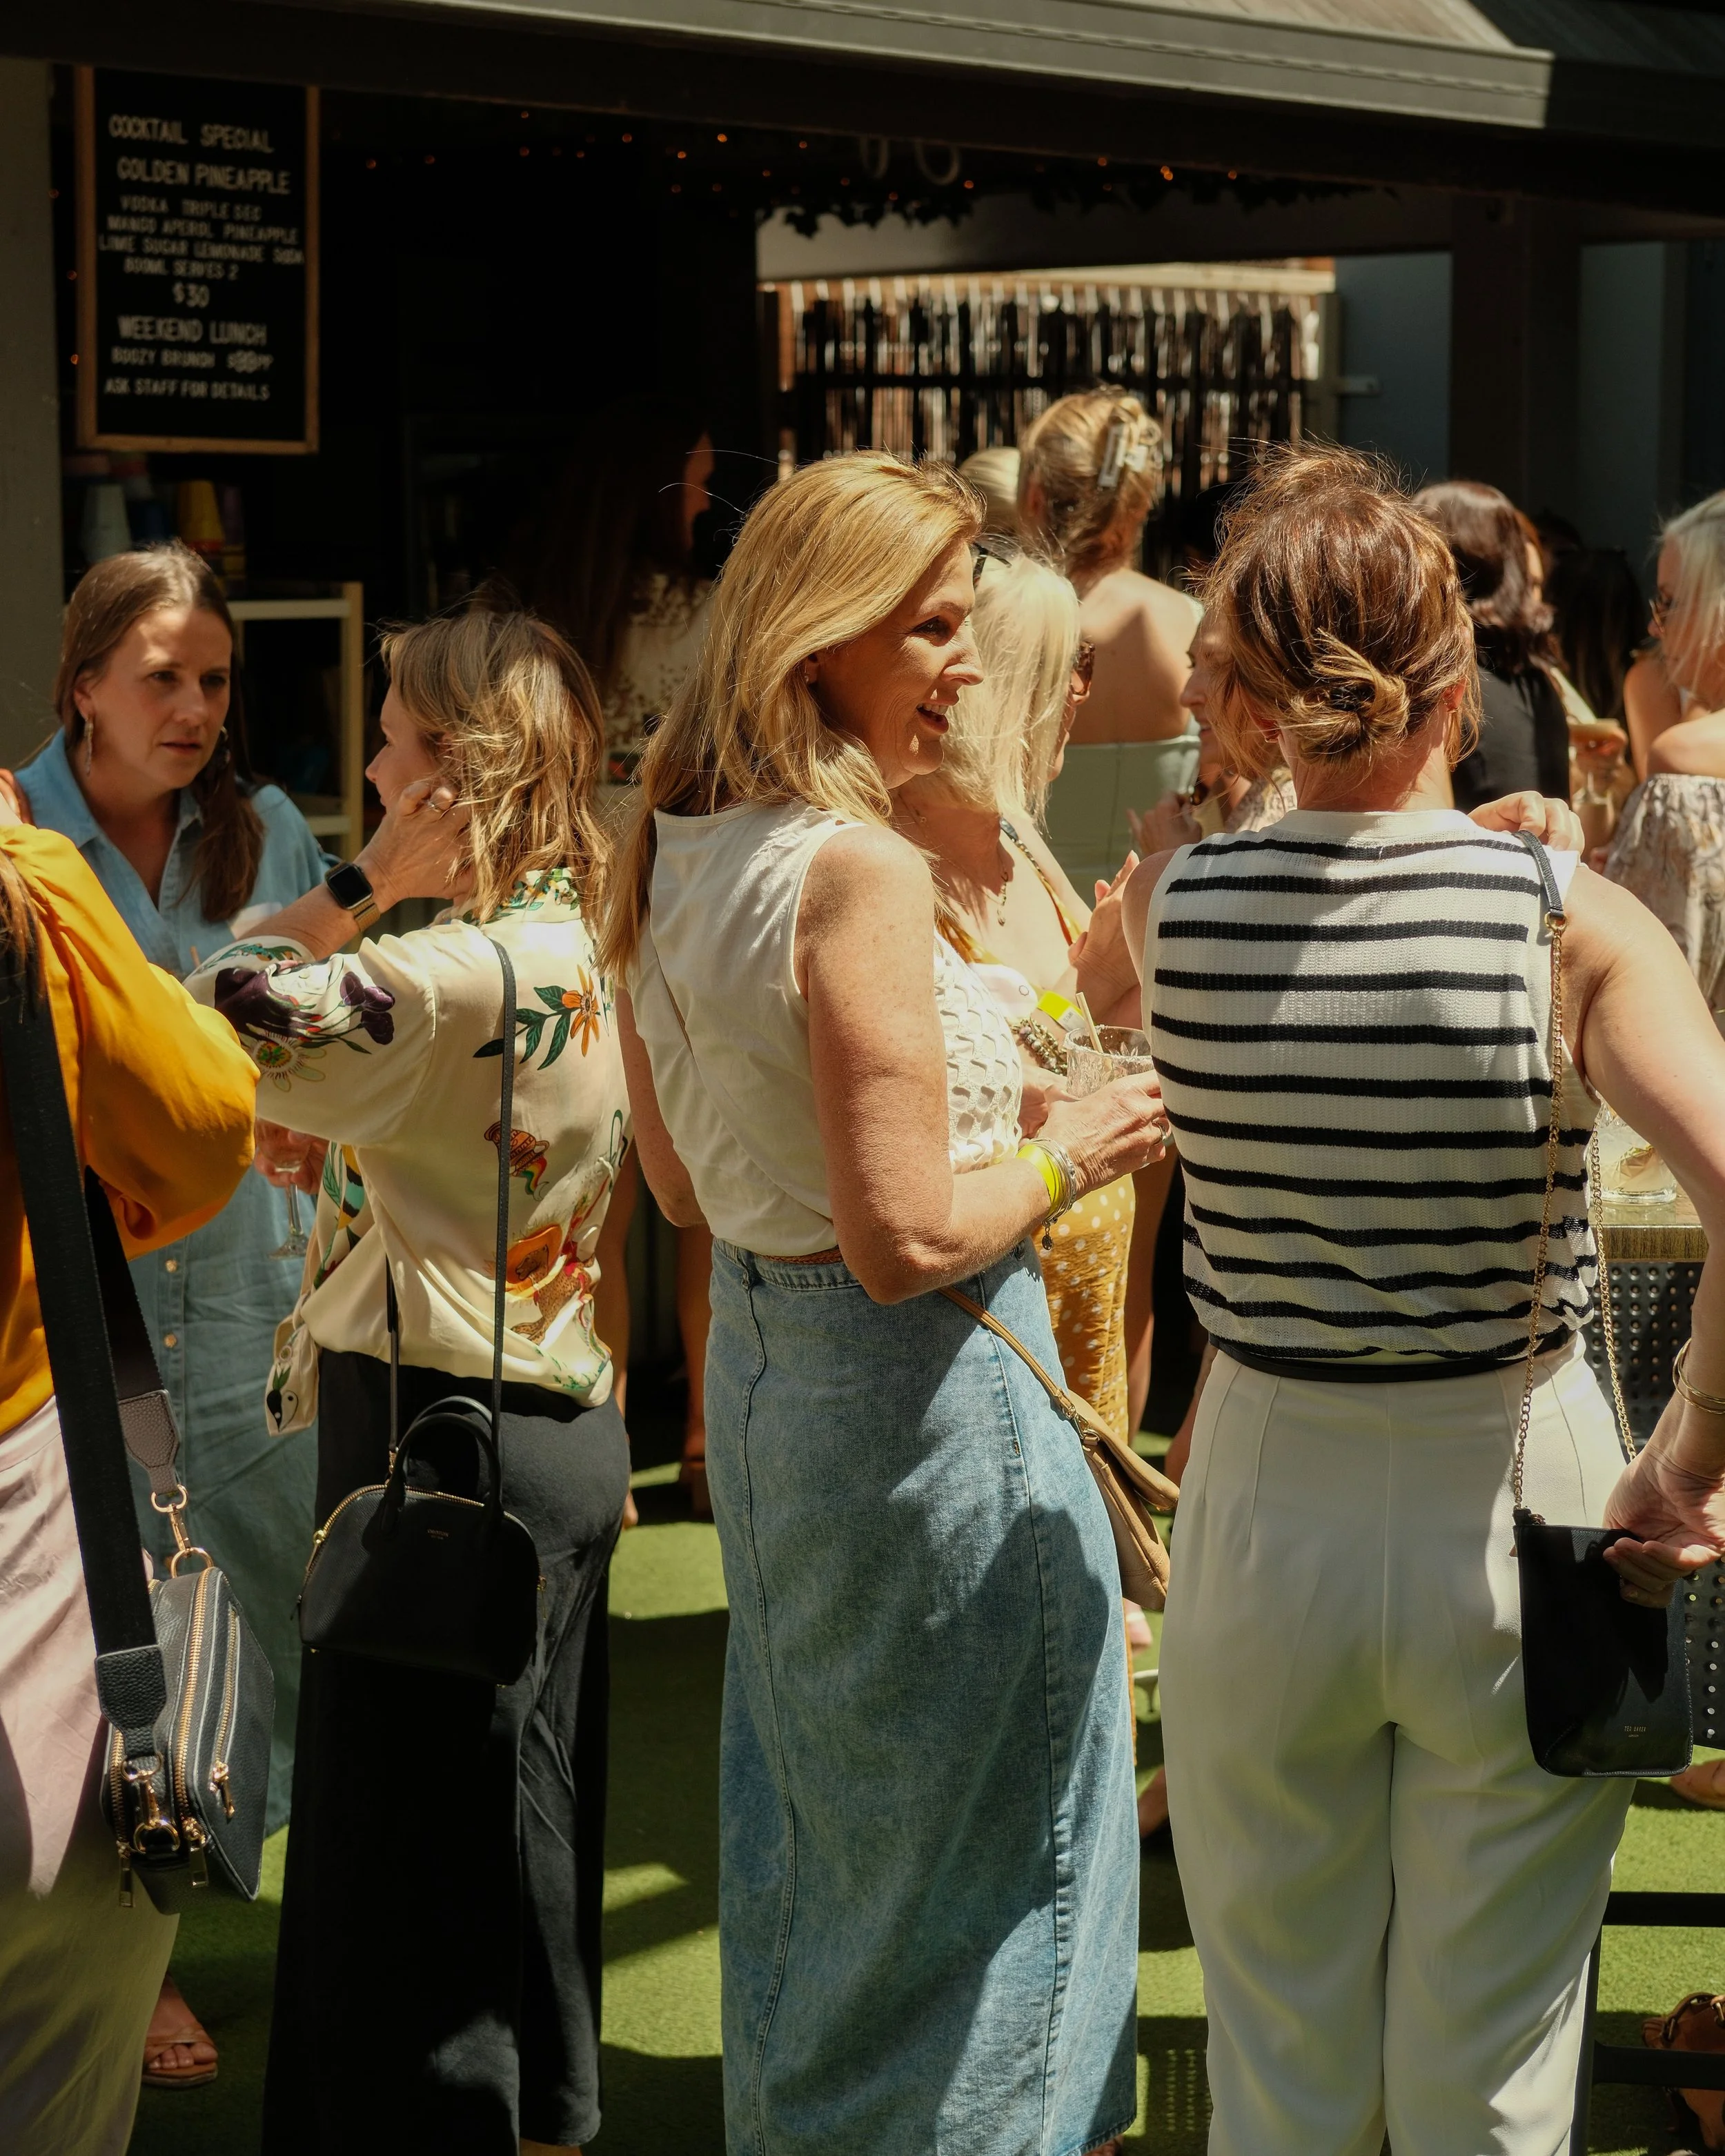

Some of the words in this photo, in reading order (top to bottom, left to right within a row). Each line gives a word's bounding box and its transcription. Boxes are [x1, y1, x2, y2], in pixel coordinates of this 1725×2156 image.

[108, 115, 189, 145] COCKTAIL
[200, 124, 274, 153] SPECIAL
[117, 157, 190, 185] GOLDEN
[195, 164, 290, 195] PINEAPPLE
[121, 195, 170, 212] VODKA
[181, 199, 228, 219] TRIPLE
[106, 215, 157, 233] MANGO
[161, 219, 213, 237] APEROL
[222, 224, 297, 244] PINEAPPLE
[99, 236, 136, 253] LIME
[143, 237, 189, 255] SUGAR
[193, 241, 264, 263] LEMONADE
[172, 259, 226, 279] SERVES
[228, 264, 239, 280] 2
[172, 282, 211, 308] $30
[117, 315, 204, 342] WEEKEND
[209, 322, 268, 345] LUNCH
[110, 346, 157, 365] BOOZY
[160, 349, 217, 368] BRUNCH
[104, 377, 132, 394] ASK
[134, 378, 178, 395] STAFF
[180, 380, 210, 397] FOR
[210, 382, 271, 401] DETAILS
